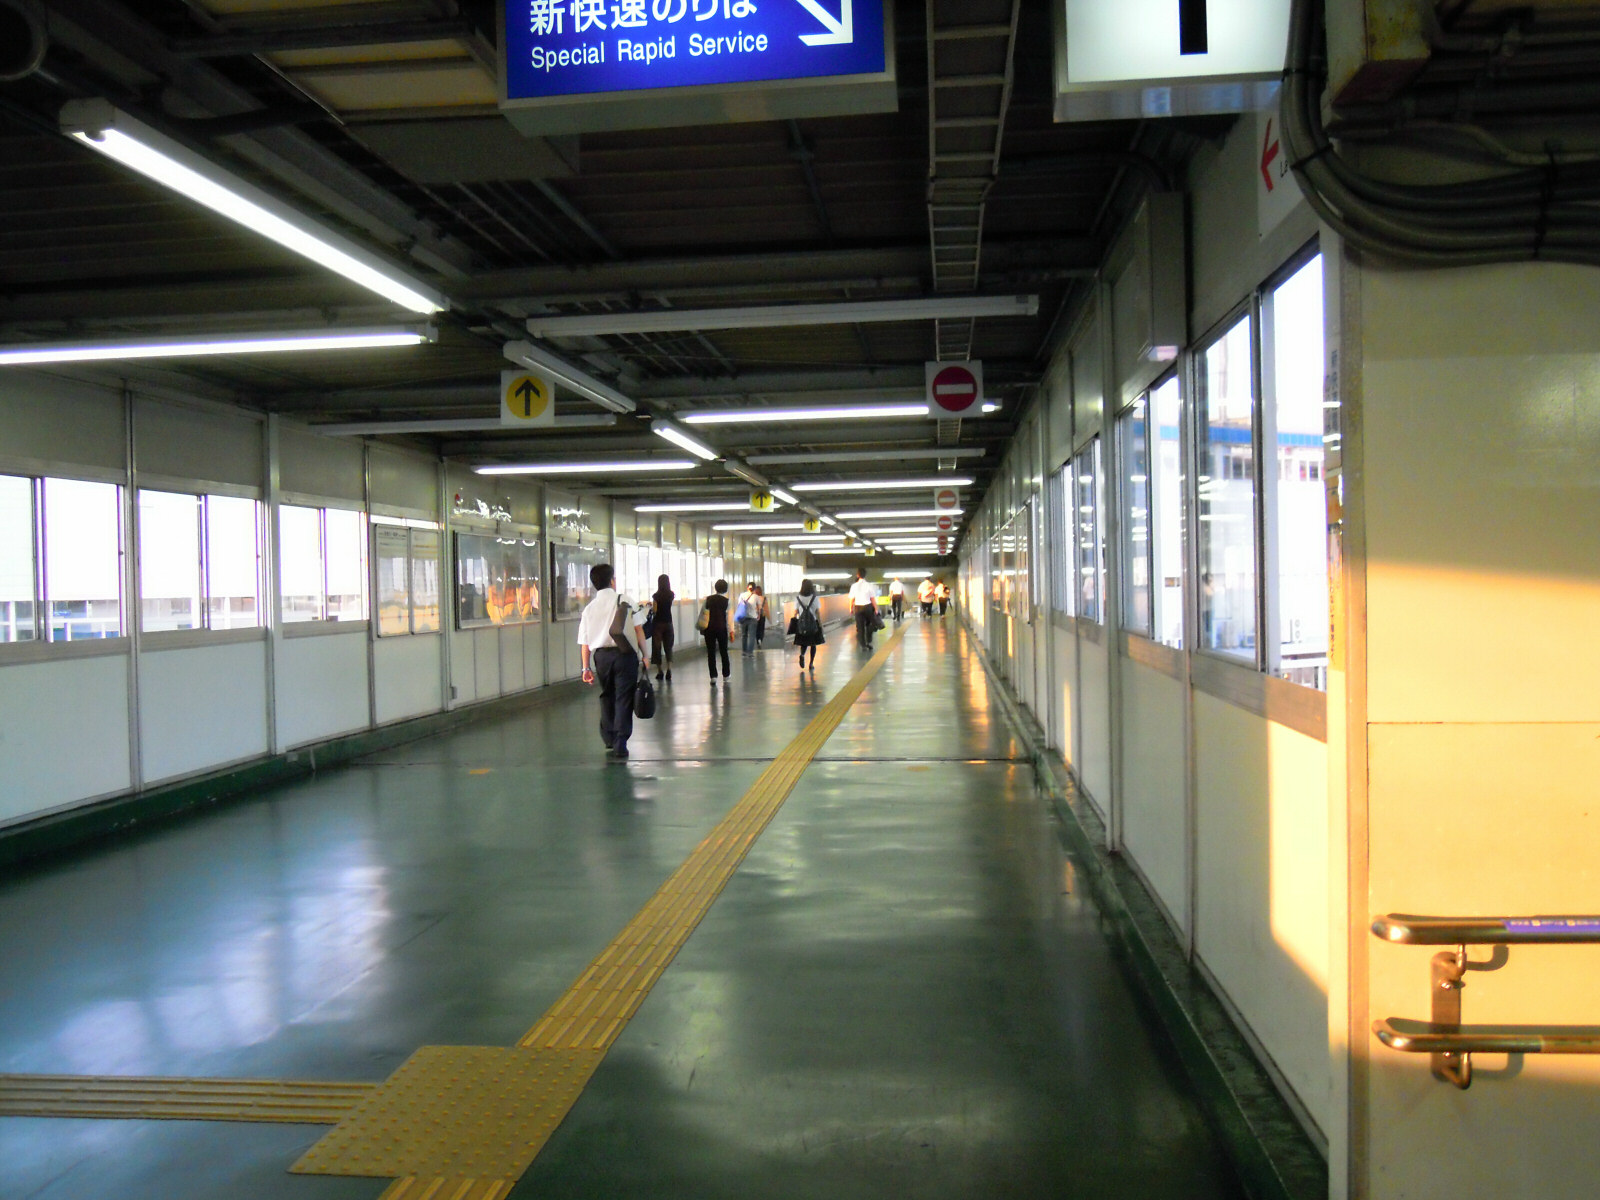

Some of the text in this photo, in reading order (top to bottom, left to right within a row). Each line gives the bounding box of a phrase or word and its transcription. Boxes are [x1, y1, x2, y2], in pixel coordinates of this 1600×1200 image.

[531, 31, 769, 73] Special Rapid Service
